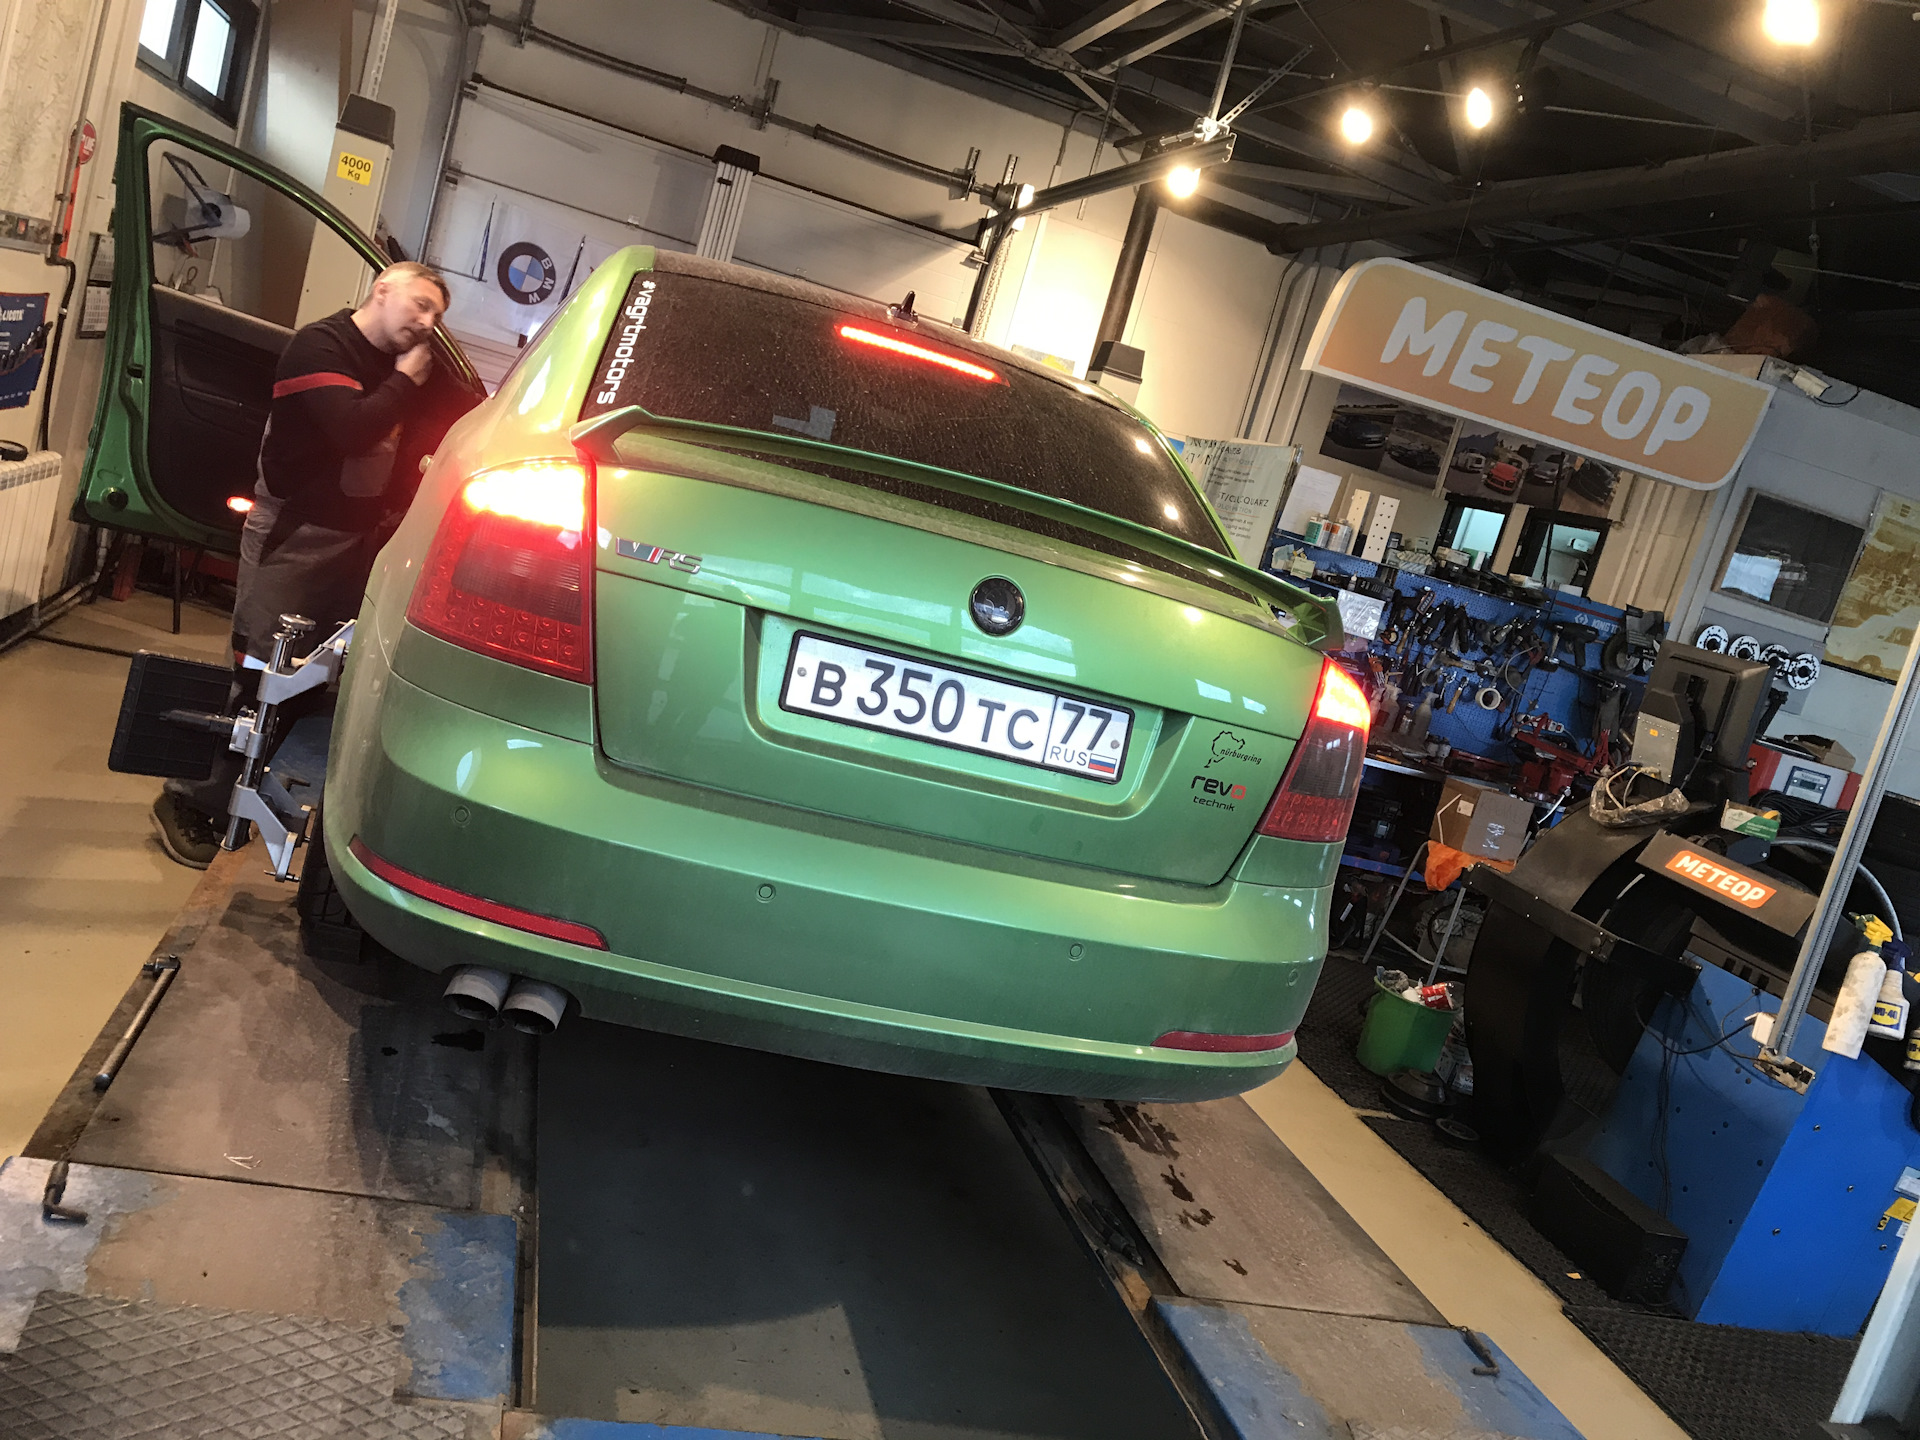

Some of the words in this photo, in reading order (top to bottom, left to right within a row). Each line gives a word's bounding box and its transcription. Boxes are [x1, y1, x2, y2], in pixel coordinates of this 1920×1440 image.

[341, 155, 371, 172] 4000
[856, 659, 965, 733] 350
[1060, 702, 1112, 751] 77
[1049, 746, 1087, 767] RUS
[1220, 748, 1262, 766] nürburgring
[1190, 775, 1247, 800] revo
[1193, 795, 1235, 812] technik
[1874, 1005, 1898, 1020] WD-40
